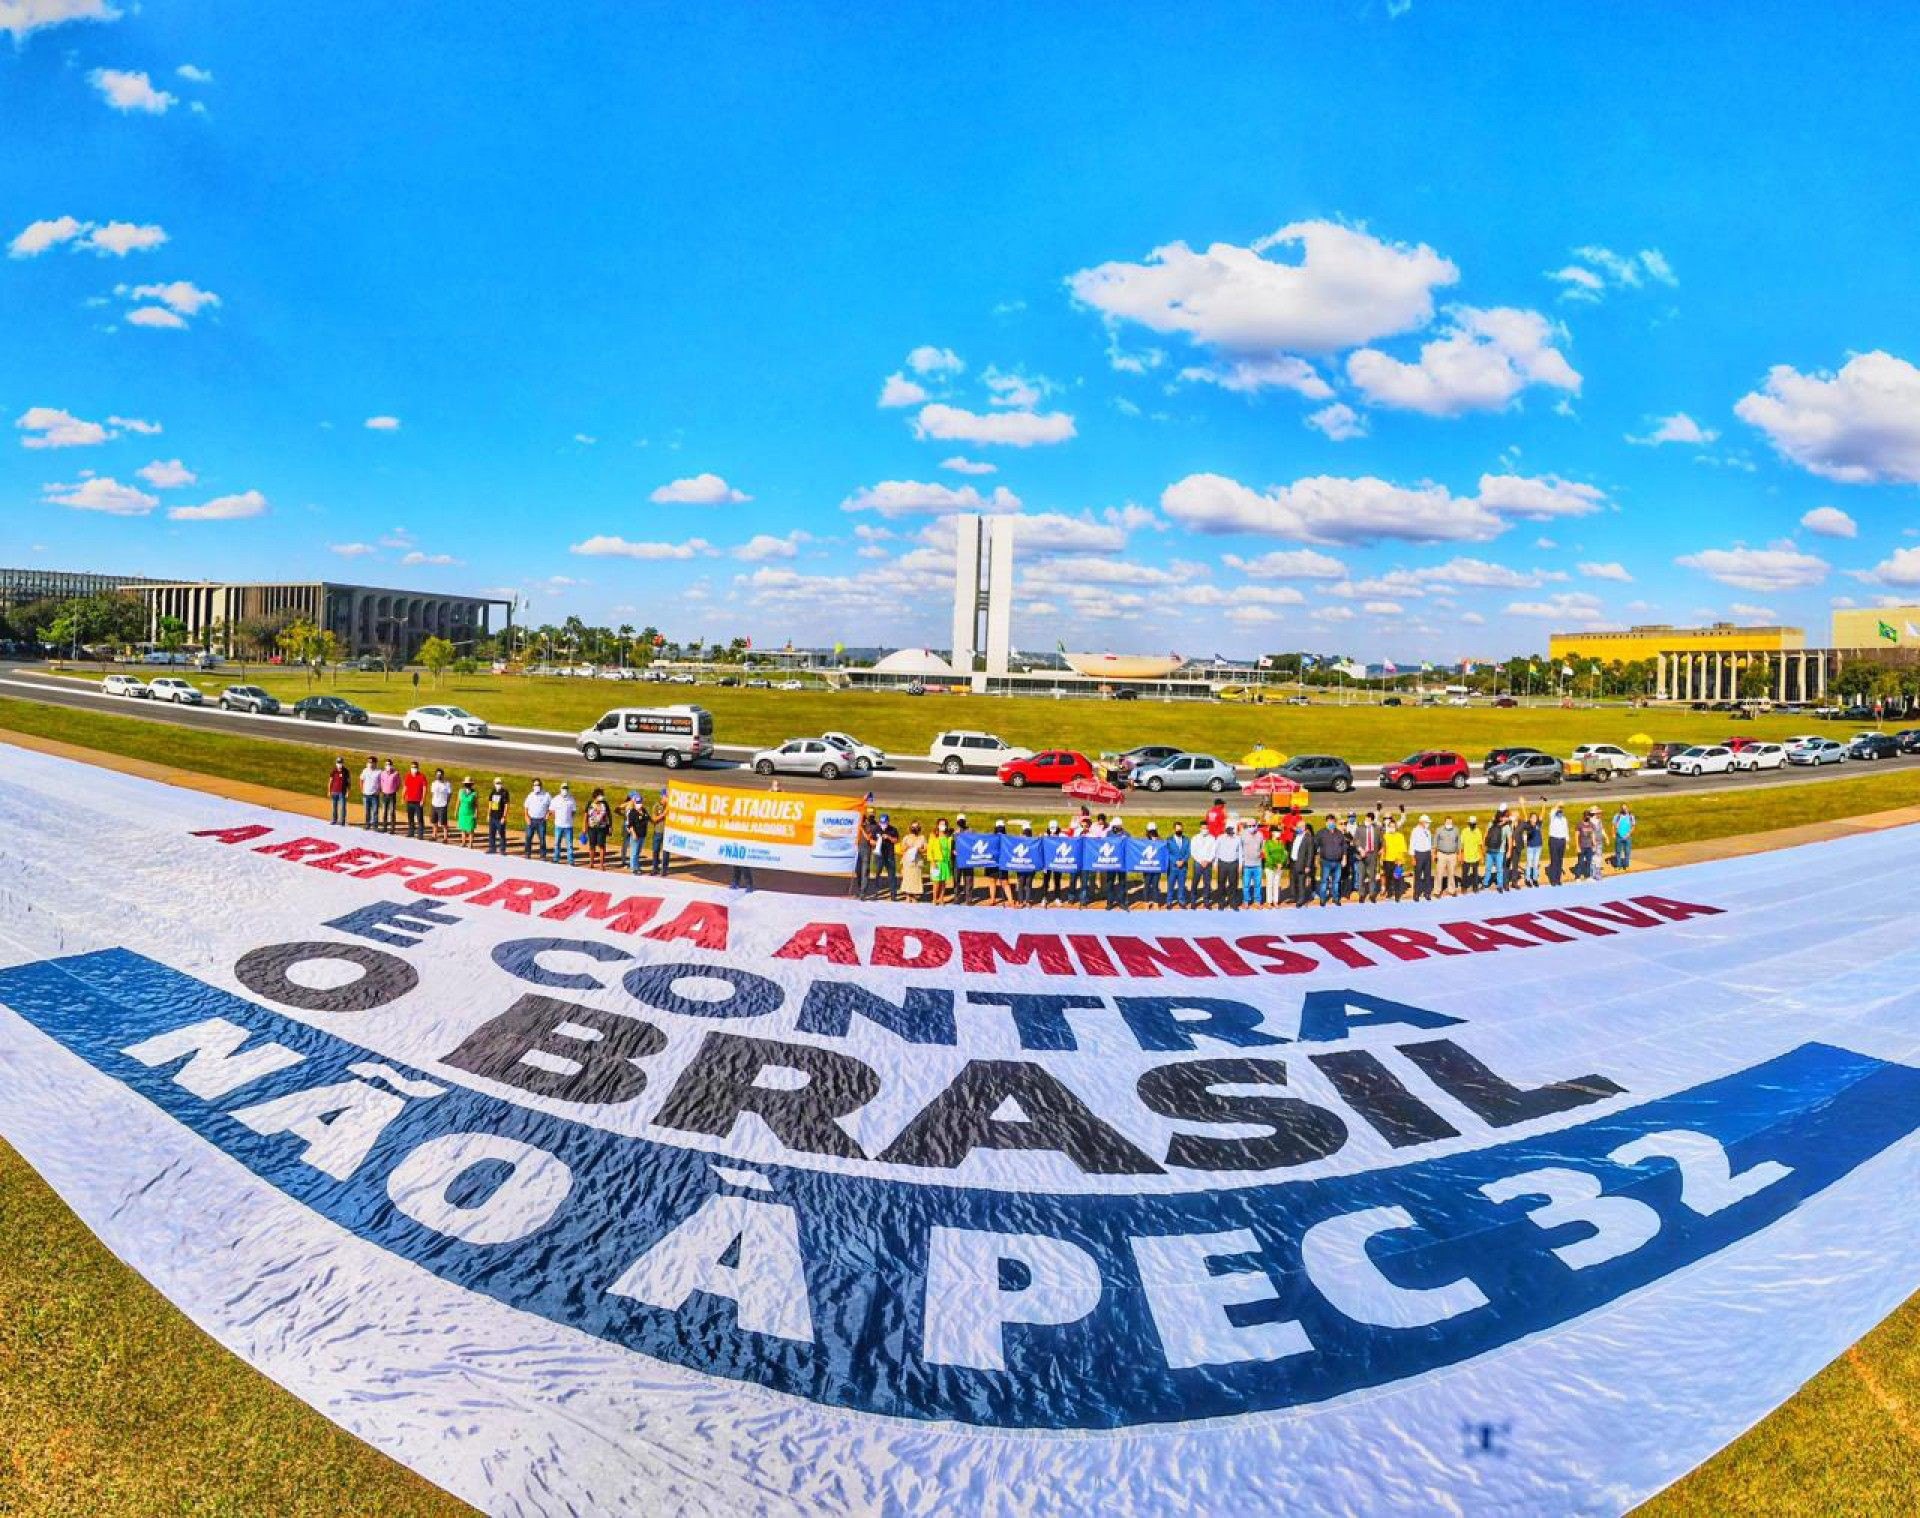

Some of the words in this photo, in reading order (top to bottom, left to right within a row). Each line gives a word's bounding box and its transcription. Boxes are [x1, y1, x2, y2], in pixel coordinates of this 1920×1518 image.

[669, 789, 708, 814] CHEGA
[710, 795, 730, 817] DE
[732, 798, 805, 821] ATAQUES
[719, 841, 746, 860] #NÃO
[822, 817, 854, 827] UNACON
[188, 824, 274, 845] A
[251, 835, 730, 951] REFORMA
[770, 895, 1727, 978] ADMINISTRATIVA
[321, 897, 463, 949] É
[490, 936, 1468, 1052] CONTRA
[234, 941, 419, 1011] O
[439, 992, 1629, 1175] BRASIL
[119, 1016, 573, 1245] NÃO
[606, 1164, 814, 1343] À
[923, 1205, 1491, 1371] PEC
[1479, 1130, 1795, 1271] 32
